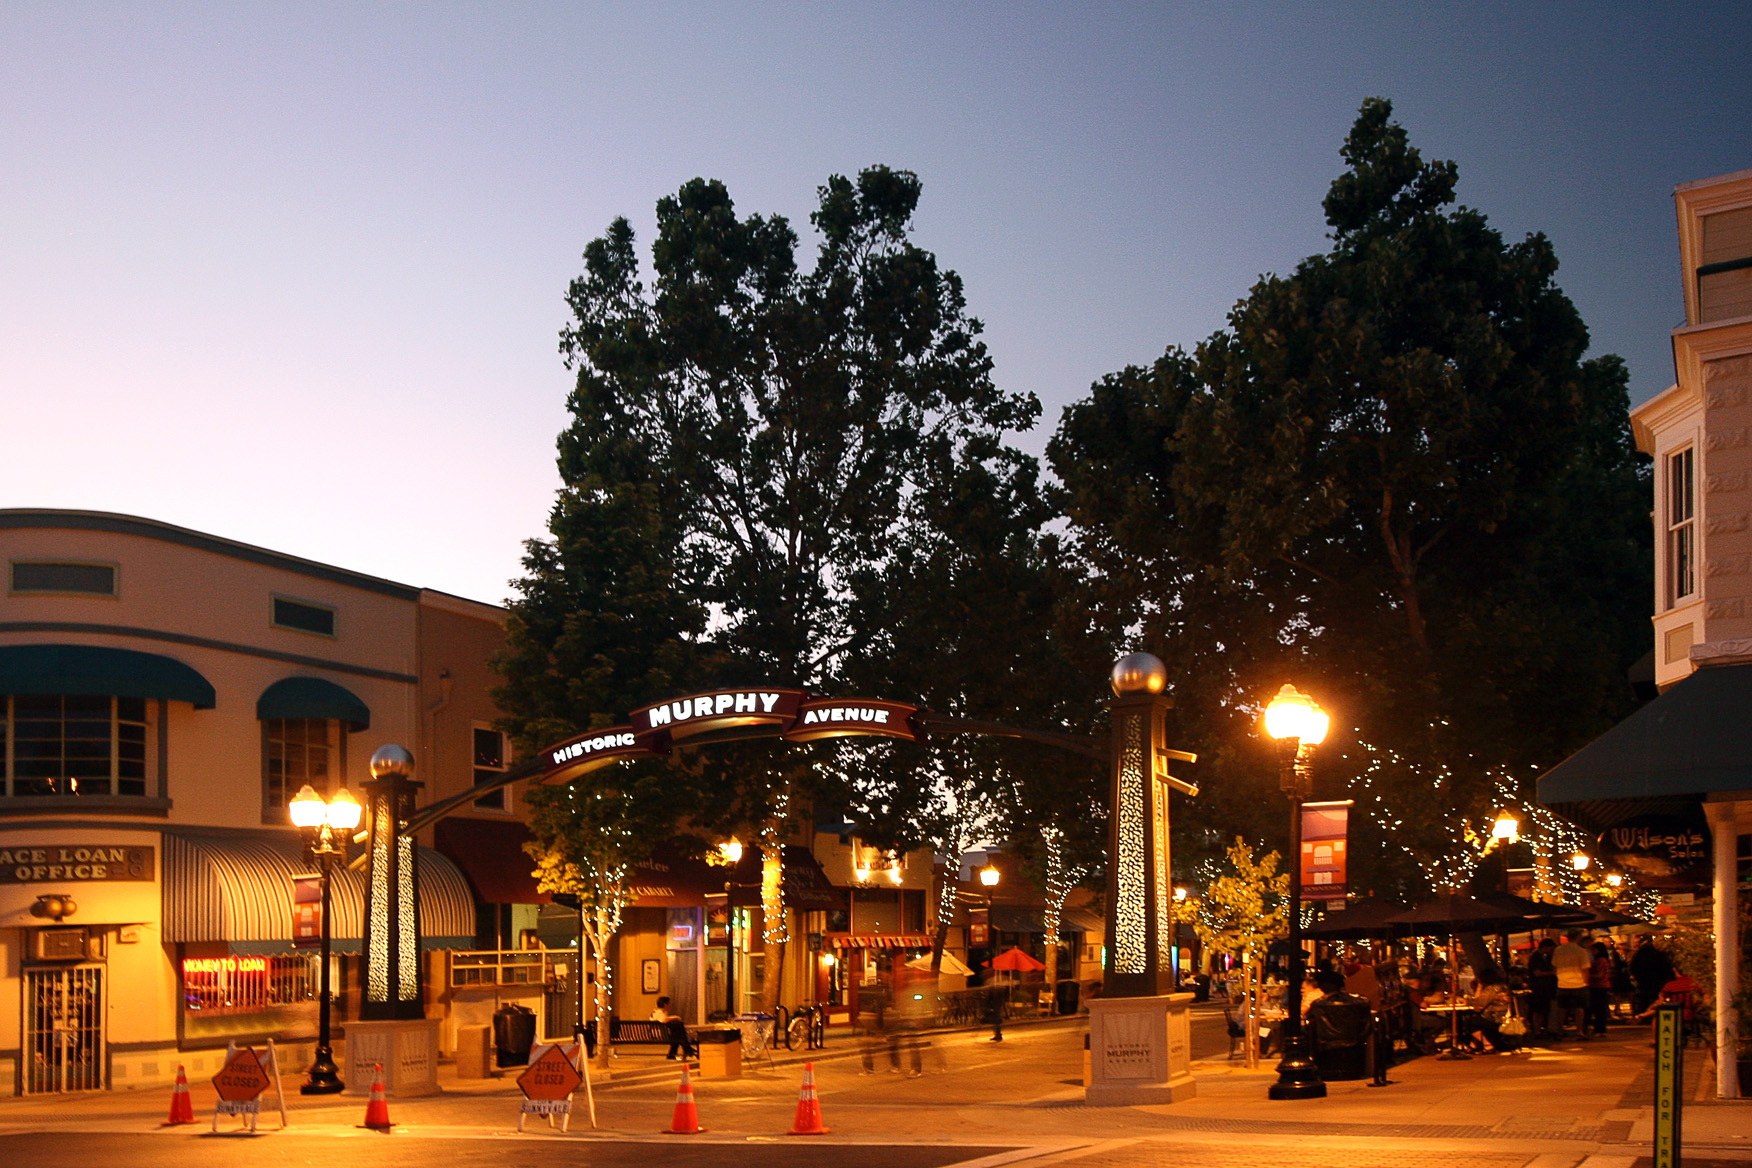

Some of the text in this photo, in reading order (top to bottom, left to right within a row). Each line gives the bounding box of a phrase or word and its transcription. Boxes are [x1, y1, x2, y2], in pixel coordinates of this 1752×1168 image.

[552, 693, 889, 764] HISTORIC MURPHY AVENUE
[1611, 827, 1705, 849] Wilson's
[0, 848, 125, 864] ACE LOAN
[15, 865, 107, 880] OFFICE
[184, 959, 265, 973] MONEY TO LOAN
[1662, 1013, 1672, 1071] WATCH
[1107, 1050, 1151, 1058] MURPHY
[536, 1062, 566, 1073] STREET
[221, 1076, 260, 1088] CLOSED
[534, 1074, 565, 1085] CLOSED
[1661, 1087, 1671, 1120] FOR
